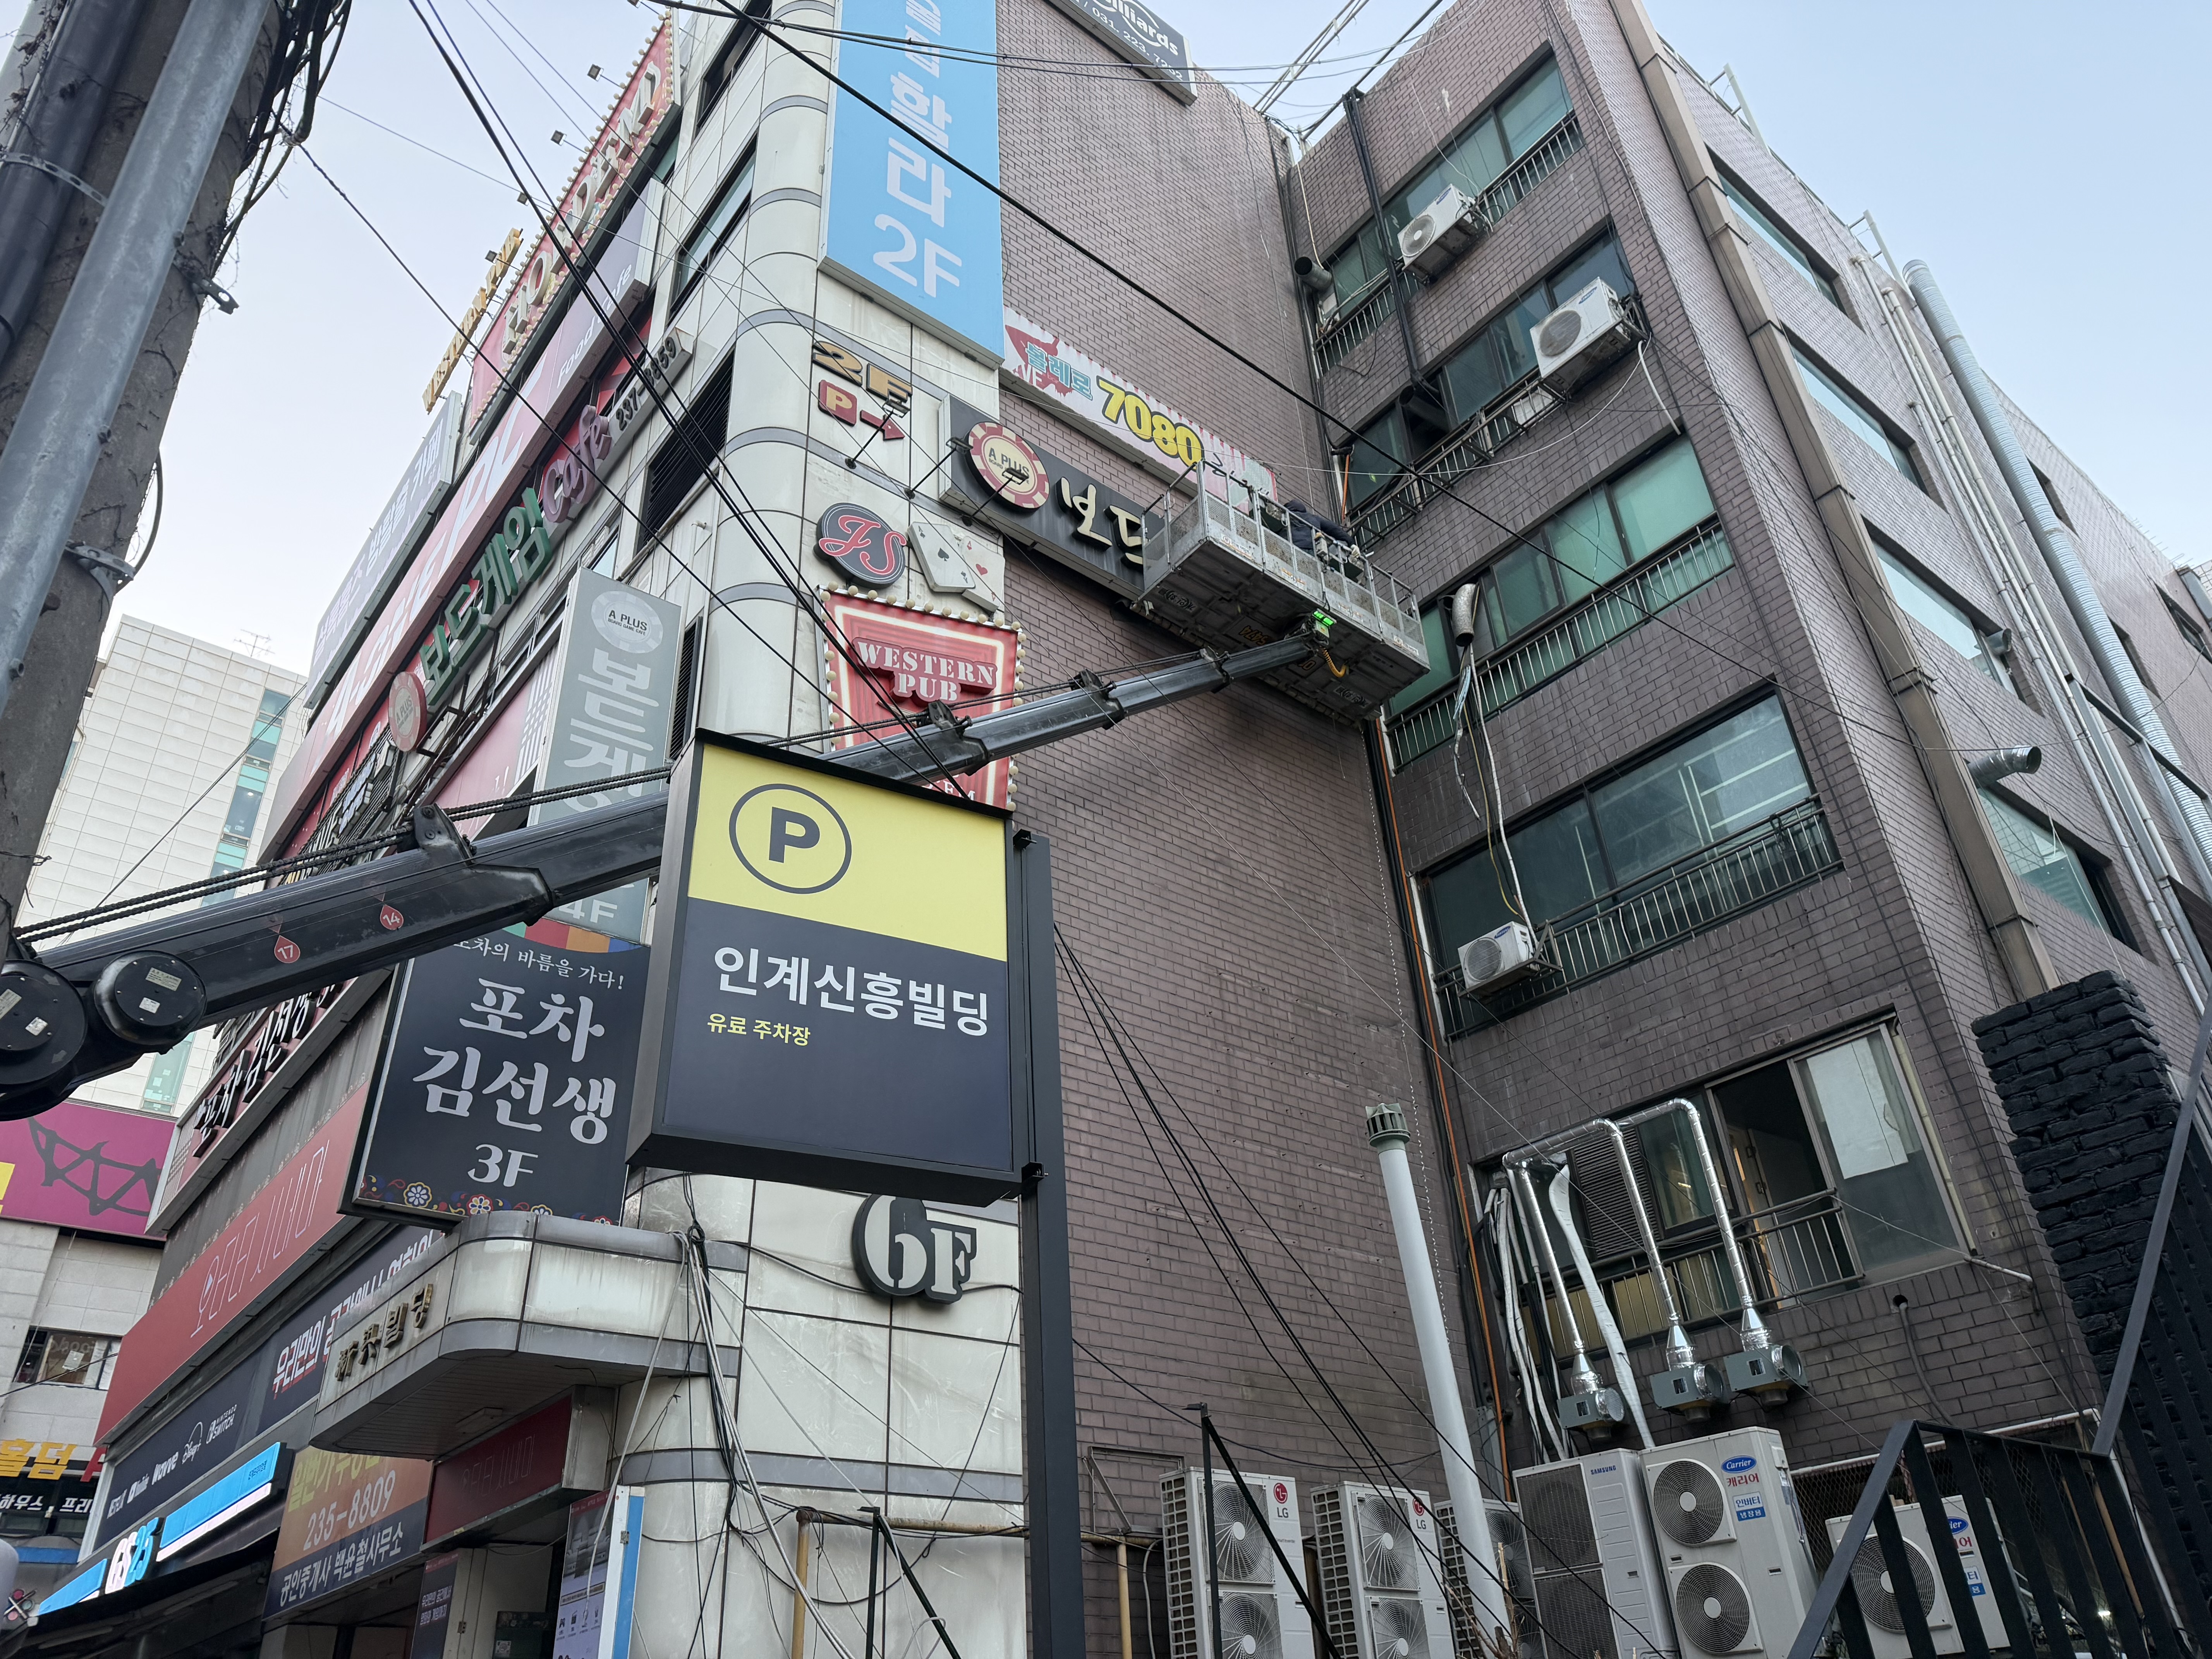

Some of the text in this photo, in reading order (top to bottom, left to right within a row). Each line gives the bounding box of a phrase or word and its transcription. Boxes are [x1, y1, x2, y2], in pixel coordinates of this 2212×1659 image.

[1106, 0, 1178, 56] illiards
[872, 213, 962, 298] 2F
[556, 314, 594, 390] Food
[813, 340, 912, 403] 2F
[826, 384, 853, 411] P
[1098, 377, 1204, 471] 7080
[410, 416, 443, 503] 카페
[438, 352, 547, 578] PC
[543, 405, 611, 522] Cafe
[989, 447, 996, 460] A
[608, 610, 647, 631] A PLUS
[858, 641, 994, 685] WESTERN
[898, 673, 958, 701] PUB
[769, 806, 821, 863] P
[383, 913, 400, 926] 14
[558, 899, 617, 923] 4F
[277, 944, 294, 959] 17
[518, 950, 573, 978] 바름을
[578, 965, 625, 990] 가다!
[714, 946, 988, 1037] 인계신흥빌딩
[459, 977, 605, 1063] 포차
[707, 1013, 811, 1047] 유료 주차장
[412, 1046, 617, 1144] 김선생
[467, 1144, 538, 1187] 3F
[864, 1195, 971, 1295] 6F
[273, 1316, 326, 1393] 우리만의
[0, 1439, 77, 1480] 홀덤
[1590, 1465, 1616, 1475] SAMSUNG
[1726, 1460, 1751, 1469] Carrier
[1726, 1473, 1759, 1487] 캐리어
[303, 1470, 396, 1551] 235-8809
[1277, 1507, 1289, 1518] LG
[1736, 1496, 1760, 1508] 인버터
[1416, 1520, 1426, 1530] LG
[105, 1517, 159, 1594] GS25
[280, 1521, 403, 1607] 공인중개사 백윤철사무소
